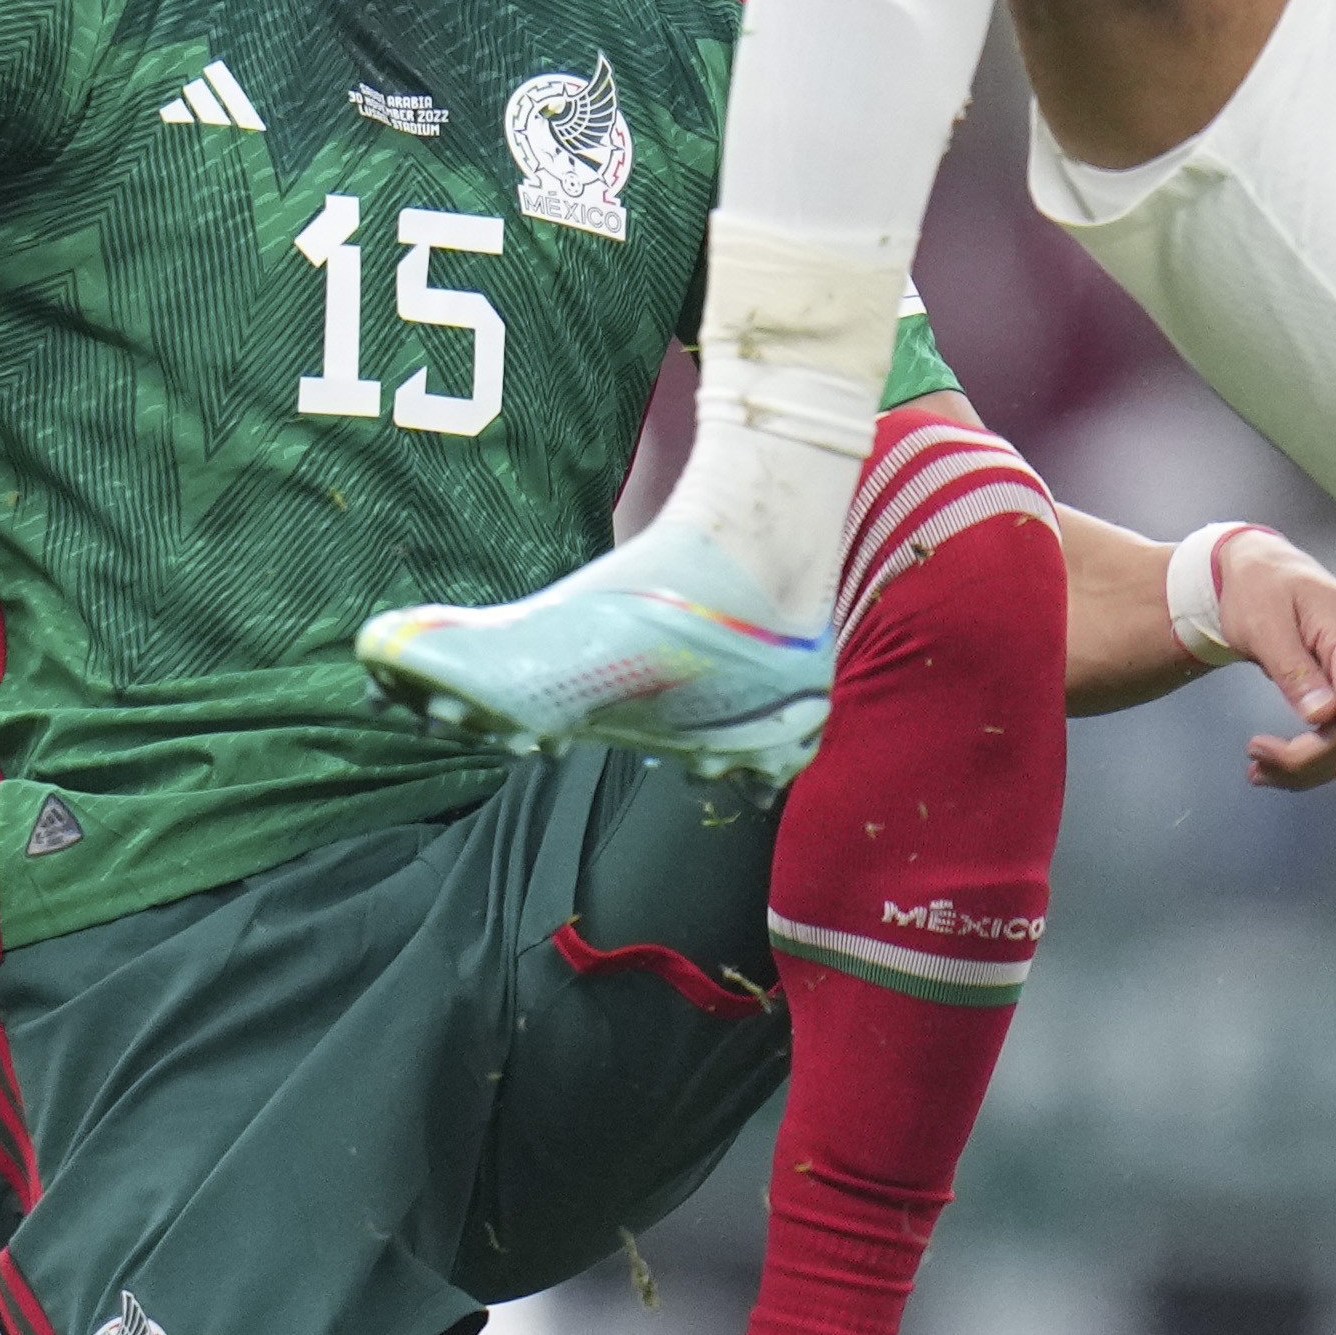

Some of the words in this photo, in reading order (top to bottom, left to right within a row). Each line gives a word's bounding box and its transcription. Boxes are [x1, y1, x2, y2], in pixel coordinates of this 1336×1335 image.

[348, 90, 364, 105] 30
[417, 109, 449, 124] 2022
[386, 95, 433, 110] ARABIA
[390, 118, 441, 137] STADIUM
[523, 190, 622, 234] MÉXICO
[294, 194, 506, 437] 15
[881, 899, 1047, 941] MÉXICO
